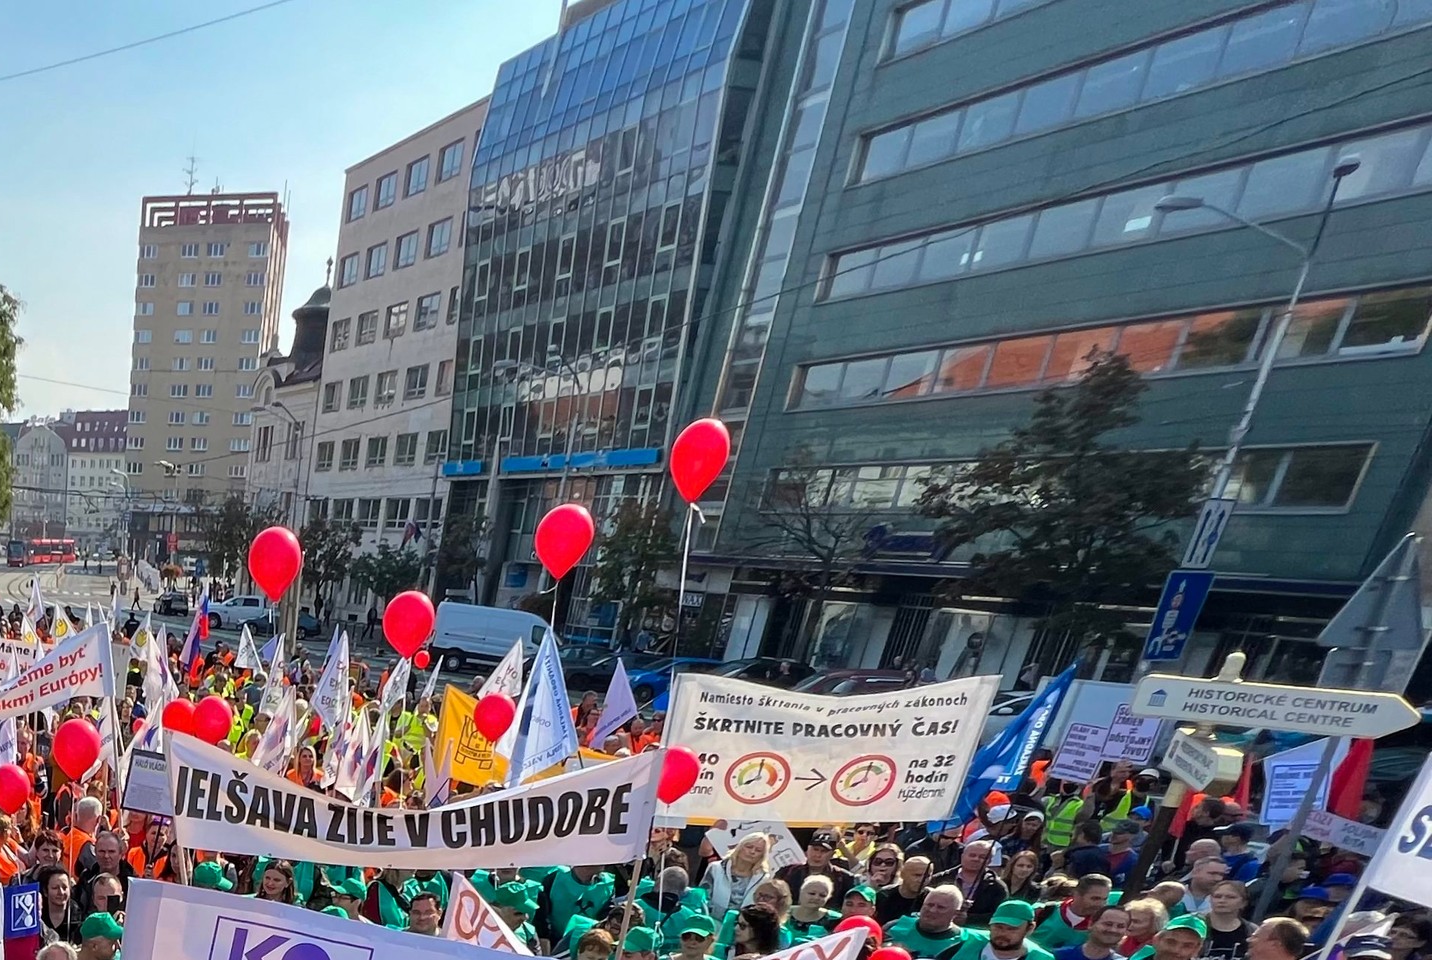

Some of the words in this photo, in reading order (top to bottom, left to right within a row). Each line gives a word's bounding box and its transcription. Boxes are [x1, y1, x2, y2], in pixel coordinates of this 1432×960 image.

[59, 643, 87, 668] byť
[40, 663, 103, 697] Európy!
[699, 691, 753, 708] Namiesto
[758, 694, 811, 712] škrtania
[815, 705, 825, 713] v
[827, 700, 900, 717] pracovných
[904, 691, 968, 709] zákonoch
[1188, 687, 1287, 707] HISTORICKÉ
[1292, 698, 1379, 715] CENTRUM
[693, 711, 785, 736] ŠKRTNITE
[792, 717, 903, 738] PRACOVNÝ
[911, 715, 959, 737] ČAS!
[1182, 701, 1278, 721] HISTORICAL
[1284, 711, 1356, 729] CENTRE
[909, 757, 929, 769] na
[932, 754, 956, 768] 32
[905, 769, 948, 784] hodín
[897, 785, 946, 802] týždenne
[175, 765, 318, 839] JELŠAVA
[405, 812, 429, 848] V
[441, 783, 633, 850] CHUDOBE
